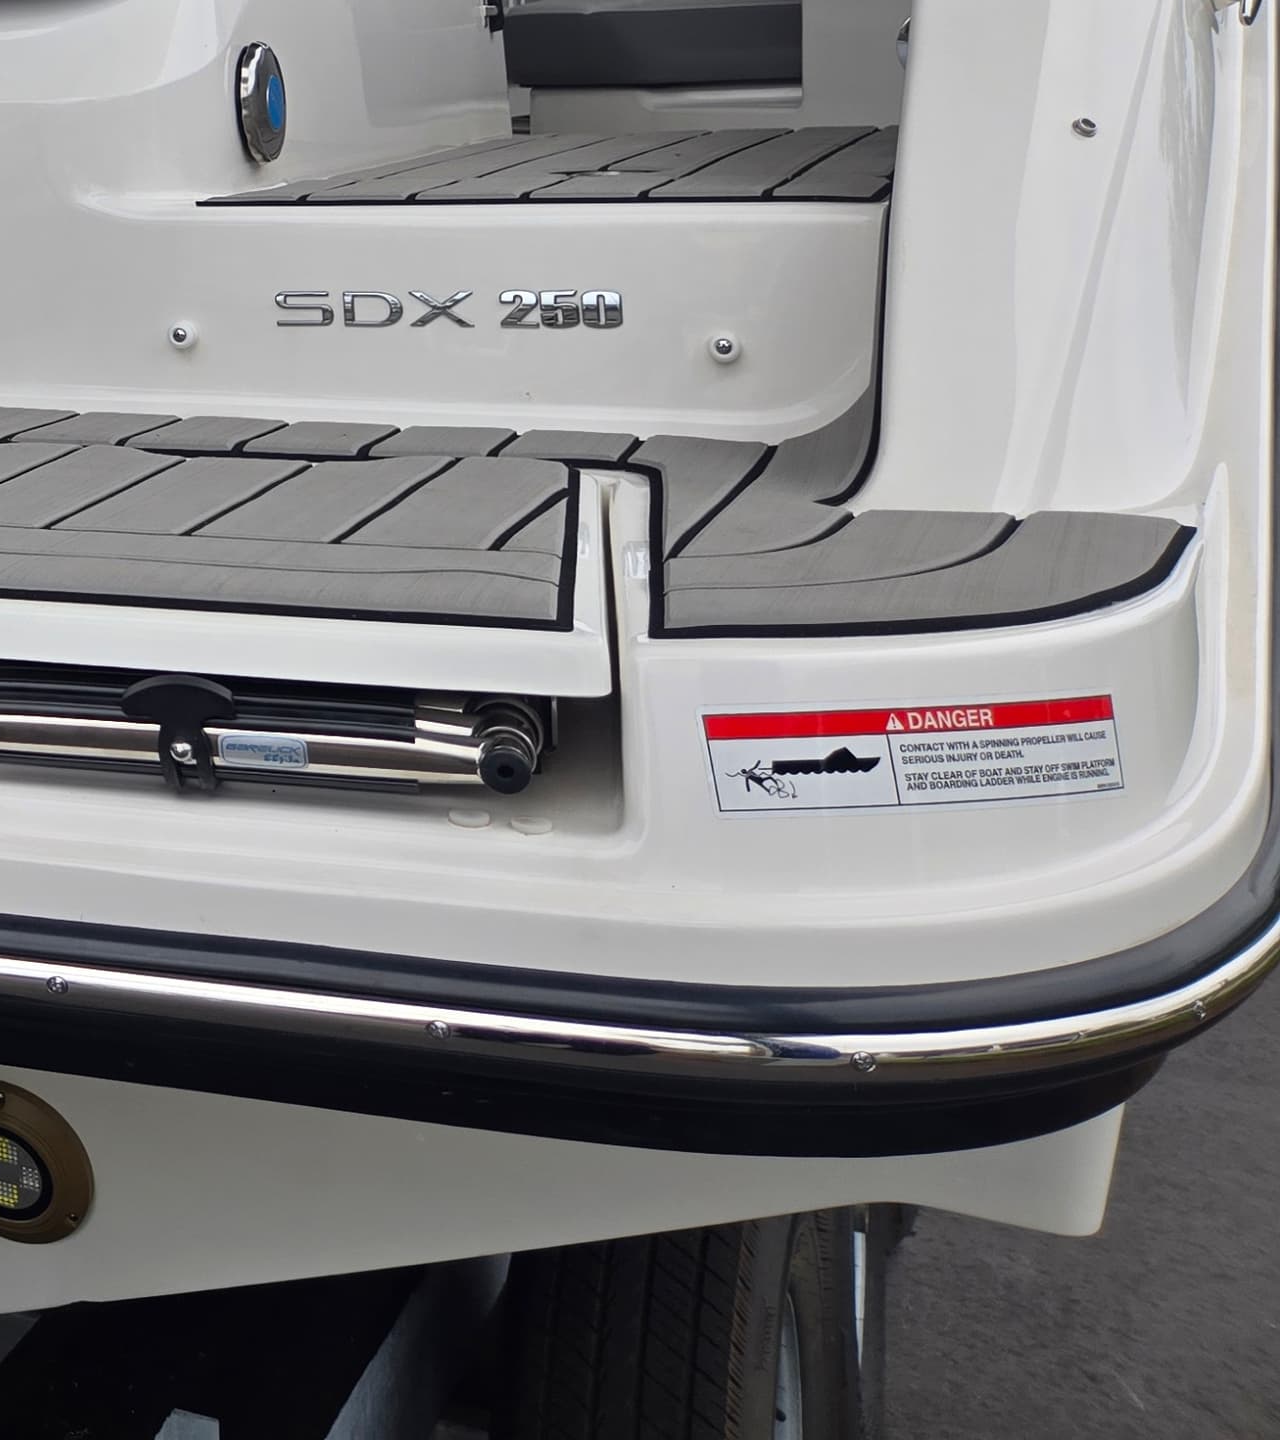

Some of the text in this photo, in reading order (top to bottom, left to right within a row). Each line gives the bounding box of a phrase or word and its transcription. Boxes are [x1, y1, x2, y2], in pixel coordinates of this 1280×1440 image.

[275, 289, 623, 329] SDX 250
[907, 708, 994, 730] DANGER
[900, 730, 1107, 753] CONTACT WITH A SPINNING PROPELLER WILL CAUSE
[901, 749, 1024, 765] SERIOUS INJURY OR DEATH.
[904, 757, 1116, 782] STAY CLEAR OF BOAT AND STAY OFF SWIM PLATFORM
[906, 768, 1110, 791] AND BOARDING LADDER WHILE ENGINE IS RUNNING.
